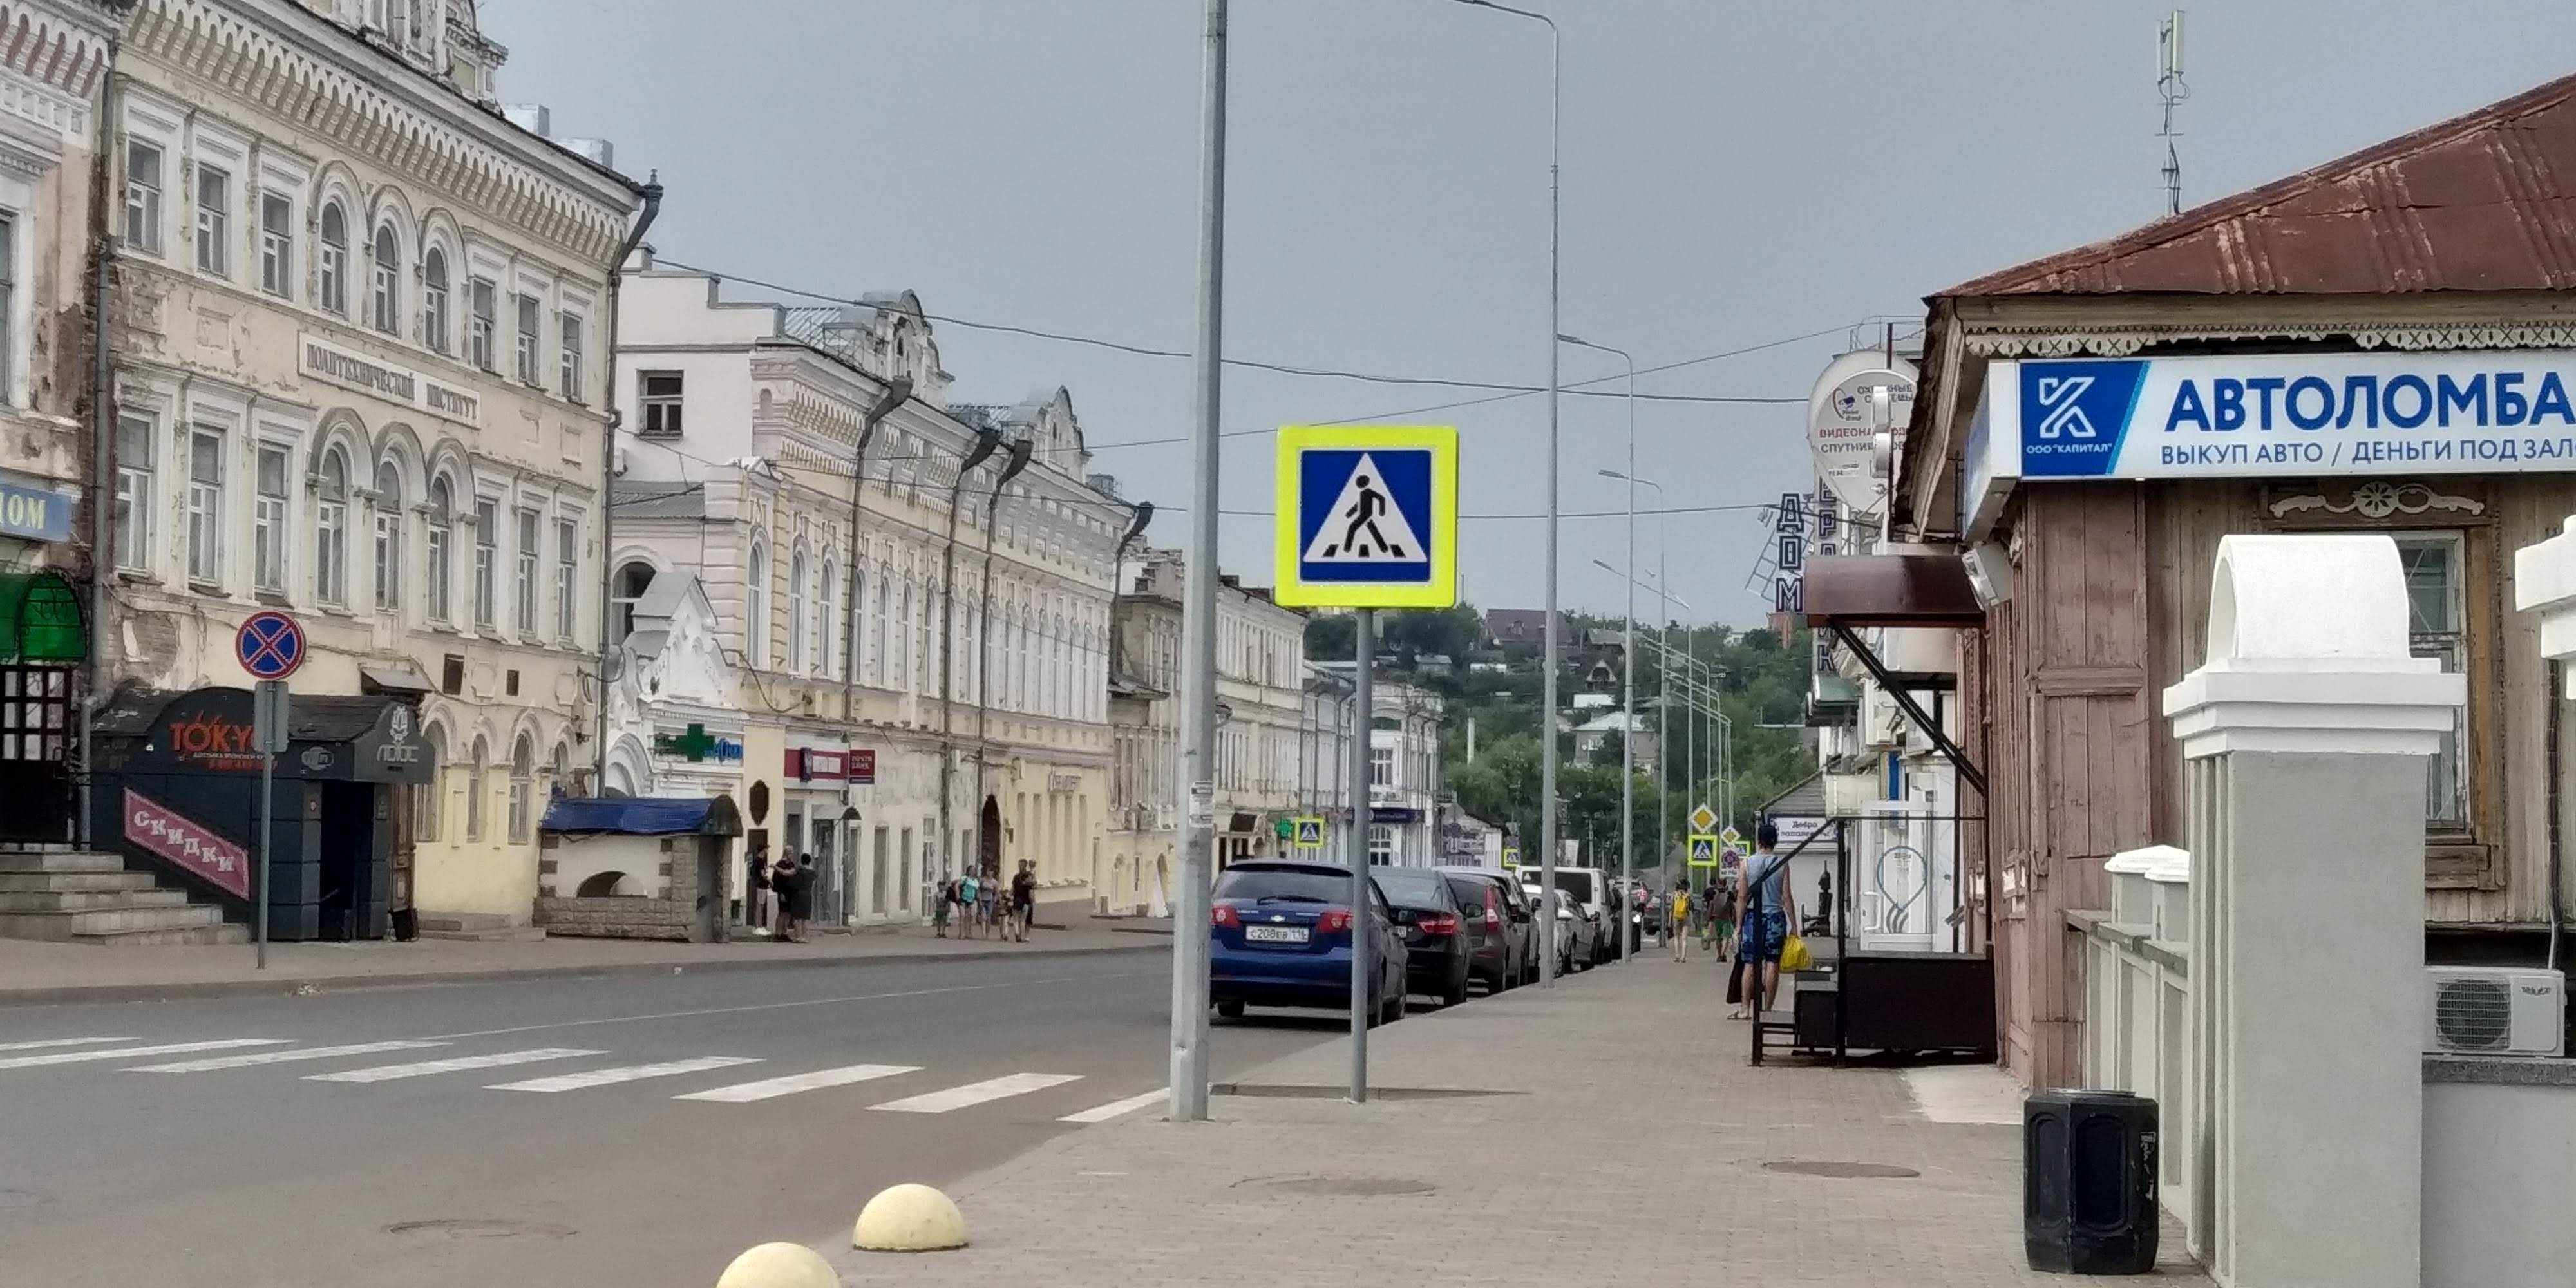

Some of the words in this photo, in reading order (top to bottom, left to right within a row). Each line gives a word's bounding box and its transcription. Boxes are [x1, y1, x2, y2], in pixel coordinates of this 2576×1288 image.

[2164, 372, 2576, 431] АВТОЛОМБА
[2027, 445, 2051, 453] ООО
[2053, 443, 2112, 453] "КАПИТАЛ"
[2161, 444, 2248, 464] ВЫКУП
[2255, 443, 2323, 462] АВТО
[2352, 440, 2451, 464] ДЕНЬГИ
[2460, 439, 2517, 462] ПОД
[2524, 438, 2576, 459] ЗАЛ
[0, 492, 45, 529] ОМ
[1776, 493, 1804, 612] ДОМ
[134, 810, 234, 872] СКИДКИ
